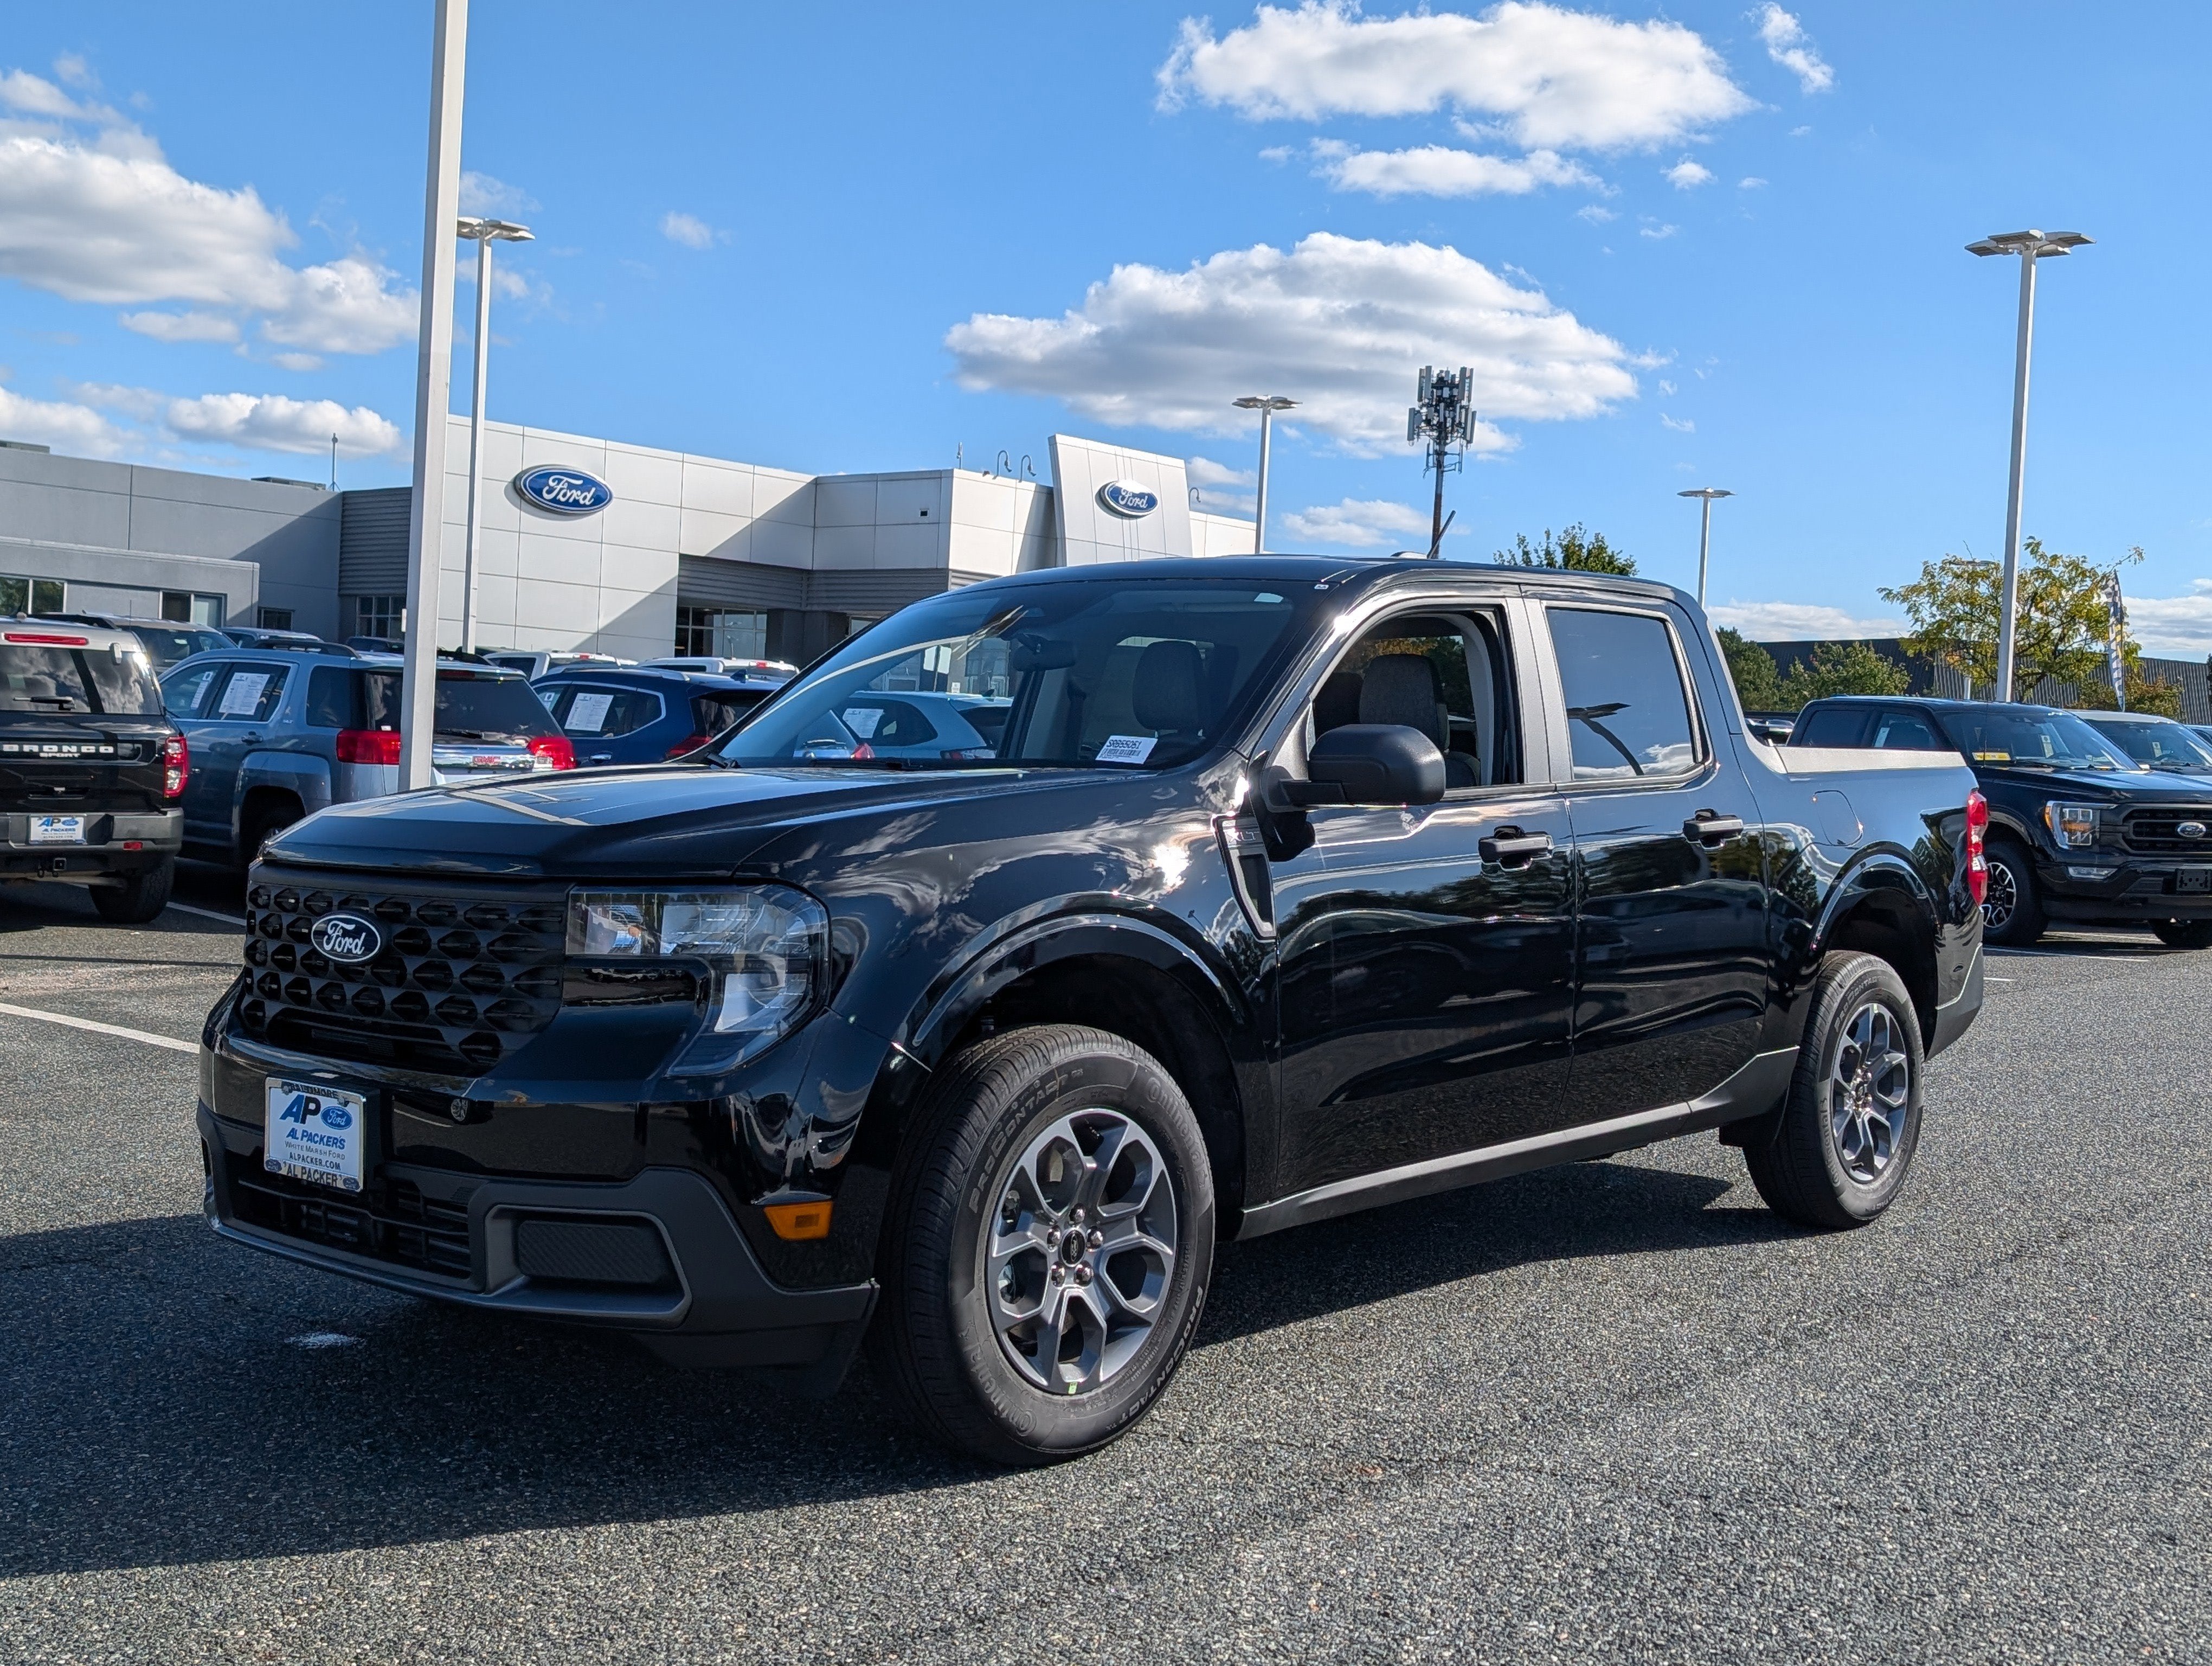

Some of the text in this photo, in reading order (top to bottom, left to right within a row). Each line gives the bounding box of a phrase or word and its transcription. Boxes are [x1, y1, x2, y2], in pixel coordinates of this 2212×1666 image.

[543, 475, 596, 505] Ford
[1118, 488, 1148, 508] Ford
[3, 744, 114, 753] BRONCO
[1227, 829, 1259, 842] XLT
[323, 920, 366, 954] Ford
[279, 1094, 346, 1125] AP Ford
[286, 1127, 346, 1150] AL PACKER'S
[285, 1140, 304, 1151] WHITE
[329, 1151, 345, 1160] FORD
[290, 1152, 342, 1170] ALPACKER.COM
[962, 1342, 1037, 1437] Continental
